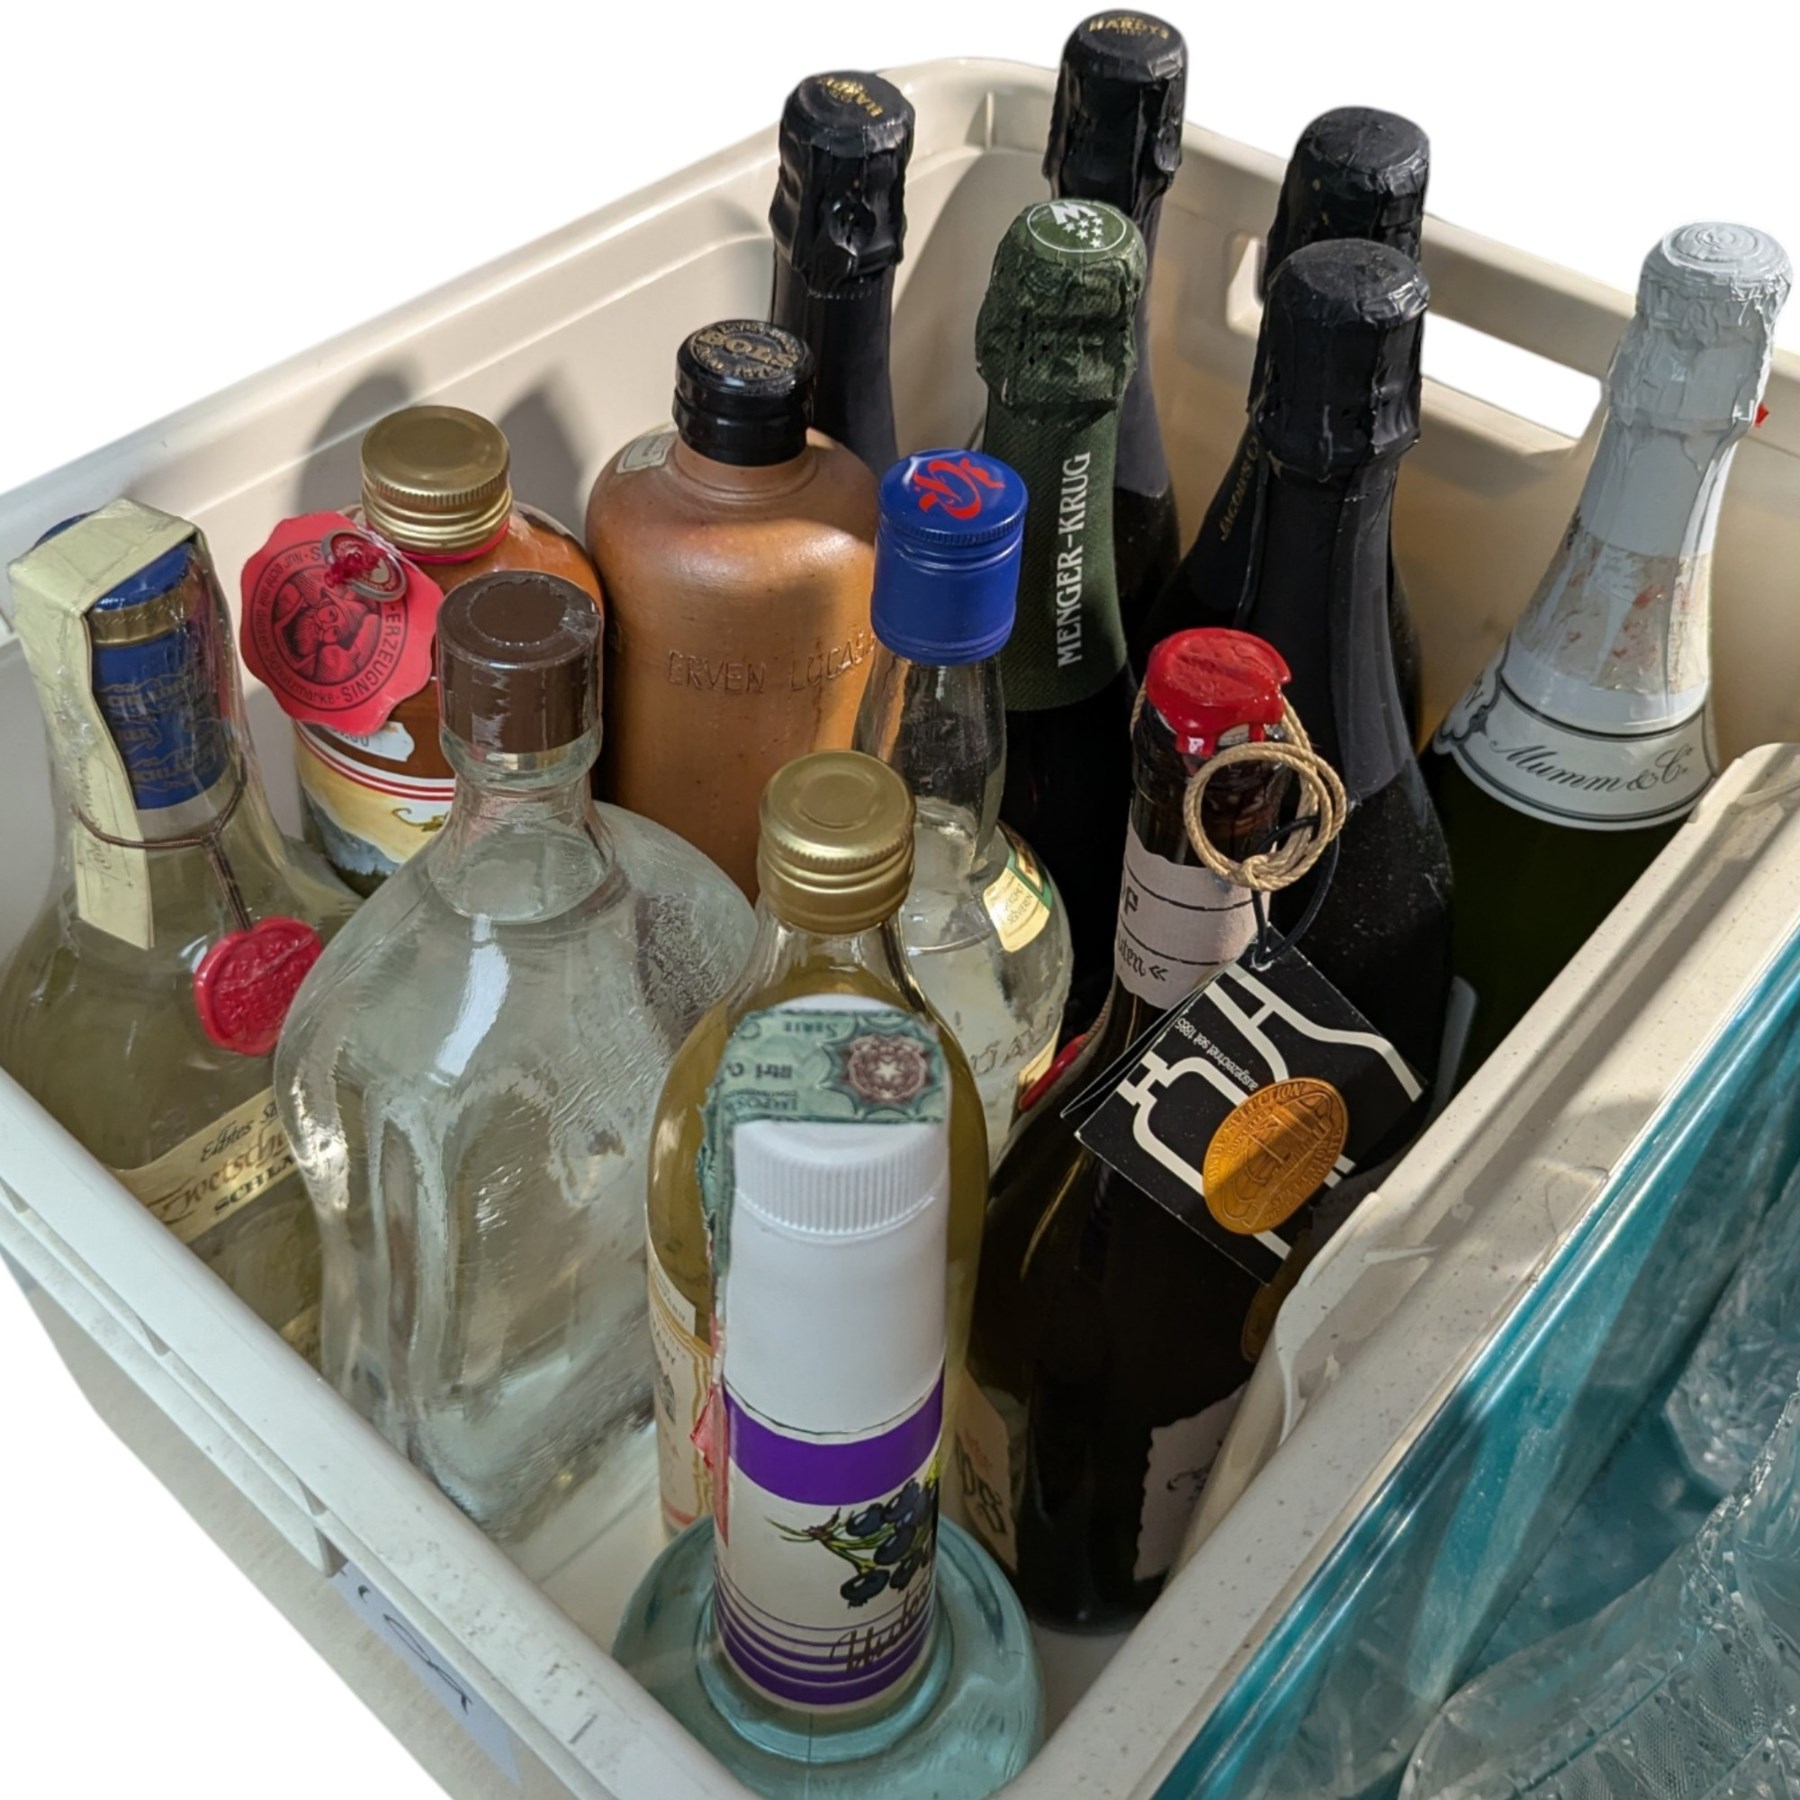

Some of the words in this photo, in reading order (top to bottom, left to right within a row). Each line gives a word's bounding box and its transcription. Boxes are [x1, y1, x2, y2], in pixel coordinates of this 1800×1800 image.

[698, 329, 798, 369] BOLS
[1056, 451, 1091, 668] MENGER-KRUG
[668, 649, 766, 693] ERVEN
[1490, 740, 1627, 793] Mumm
[1174, 1017, 1198, 1040] 1885
